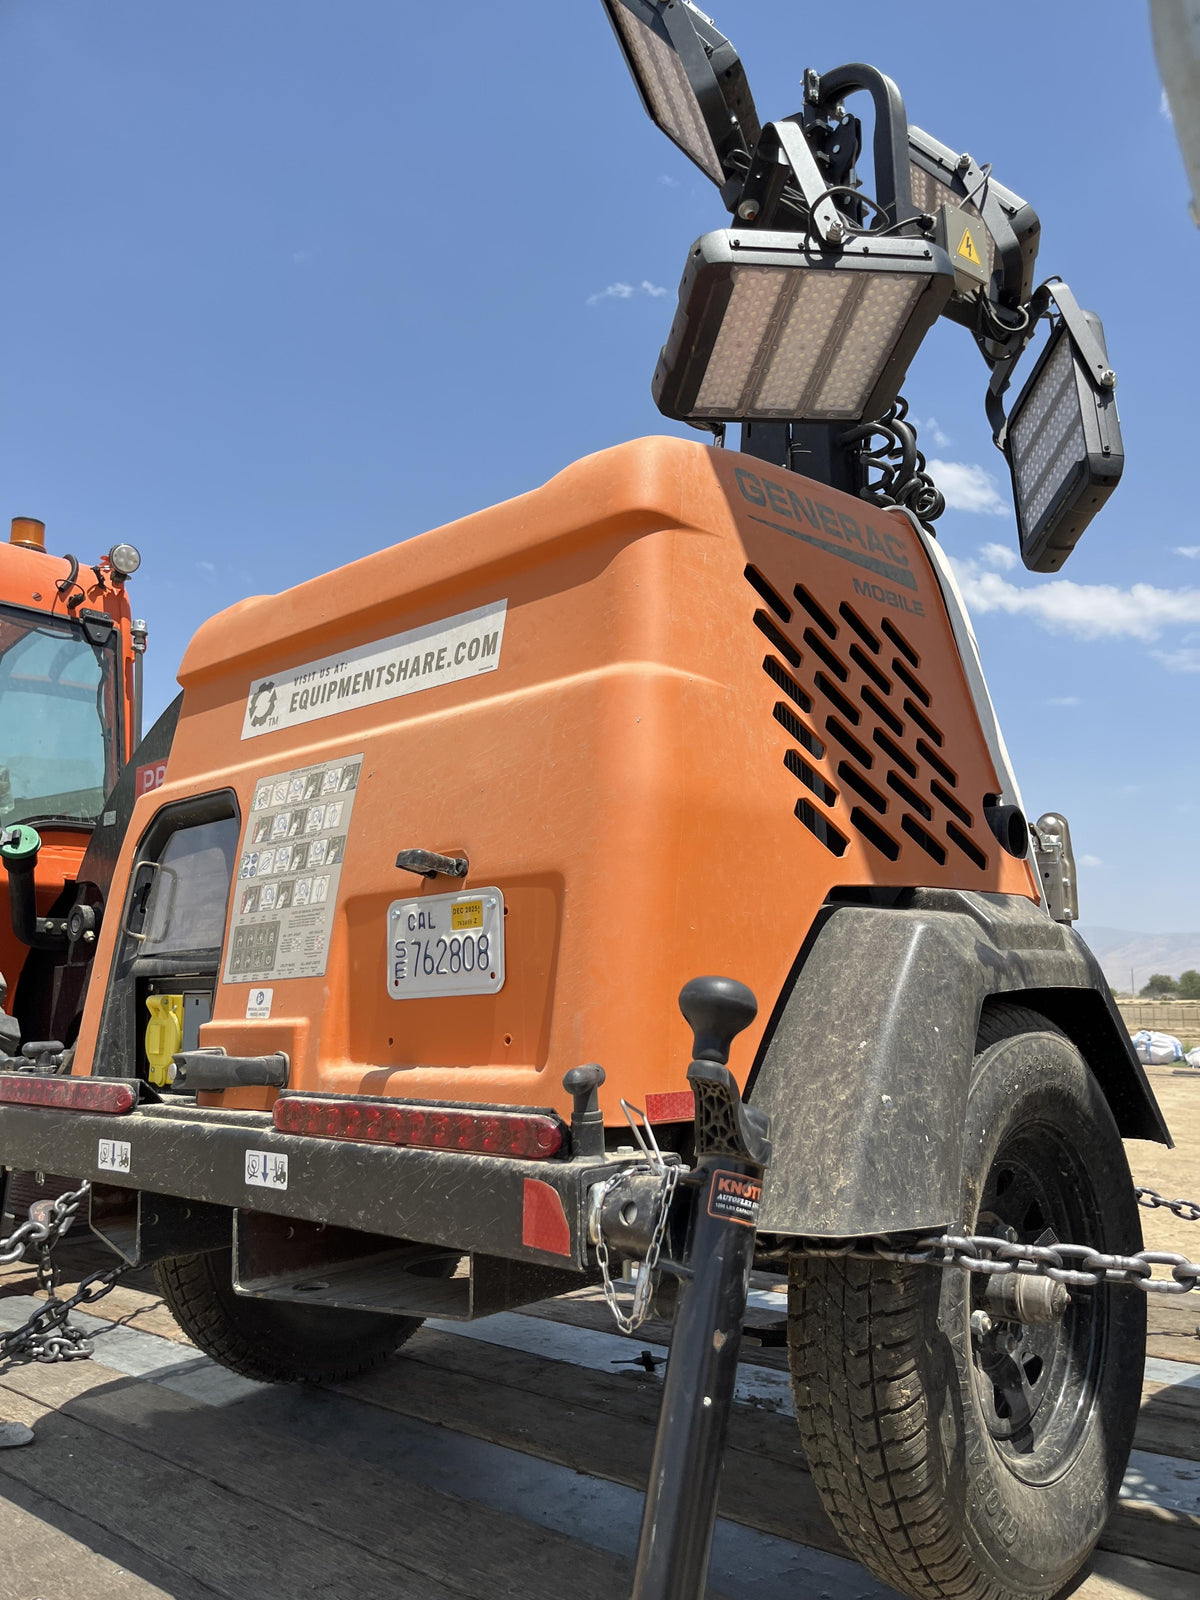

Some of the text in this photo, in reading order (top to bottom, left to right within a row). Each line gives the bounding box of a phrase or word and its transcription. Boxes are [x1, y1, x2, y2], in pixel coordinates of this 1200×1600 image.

[734, 467, 909, 566] GENERAC
[852, 577, 926, 617] MOBILE
[289, 631, 499, 713] EQUIPMENTSHARE.COM
[294, 662, 348, 686] VISIT US AT:
[268, 716, 279, 727] TM
[407, 911, 436, 931] CAL
[452, 907, 463, 915] DEC
[411, 934, 490, 978] 762808
